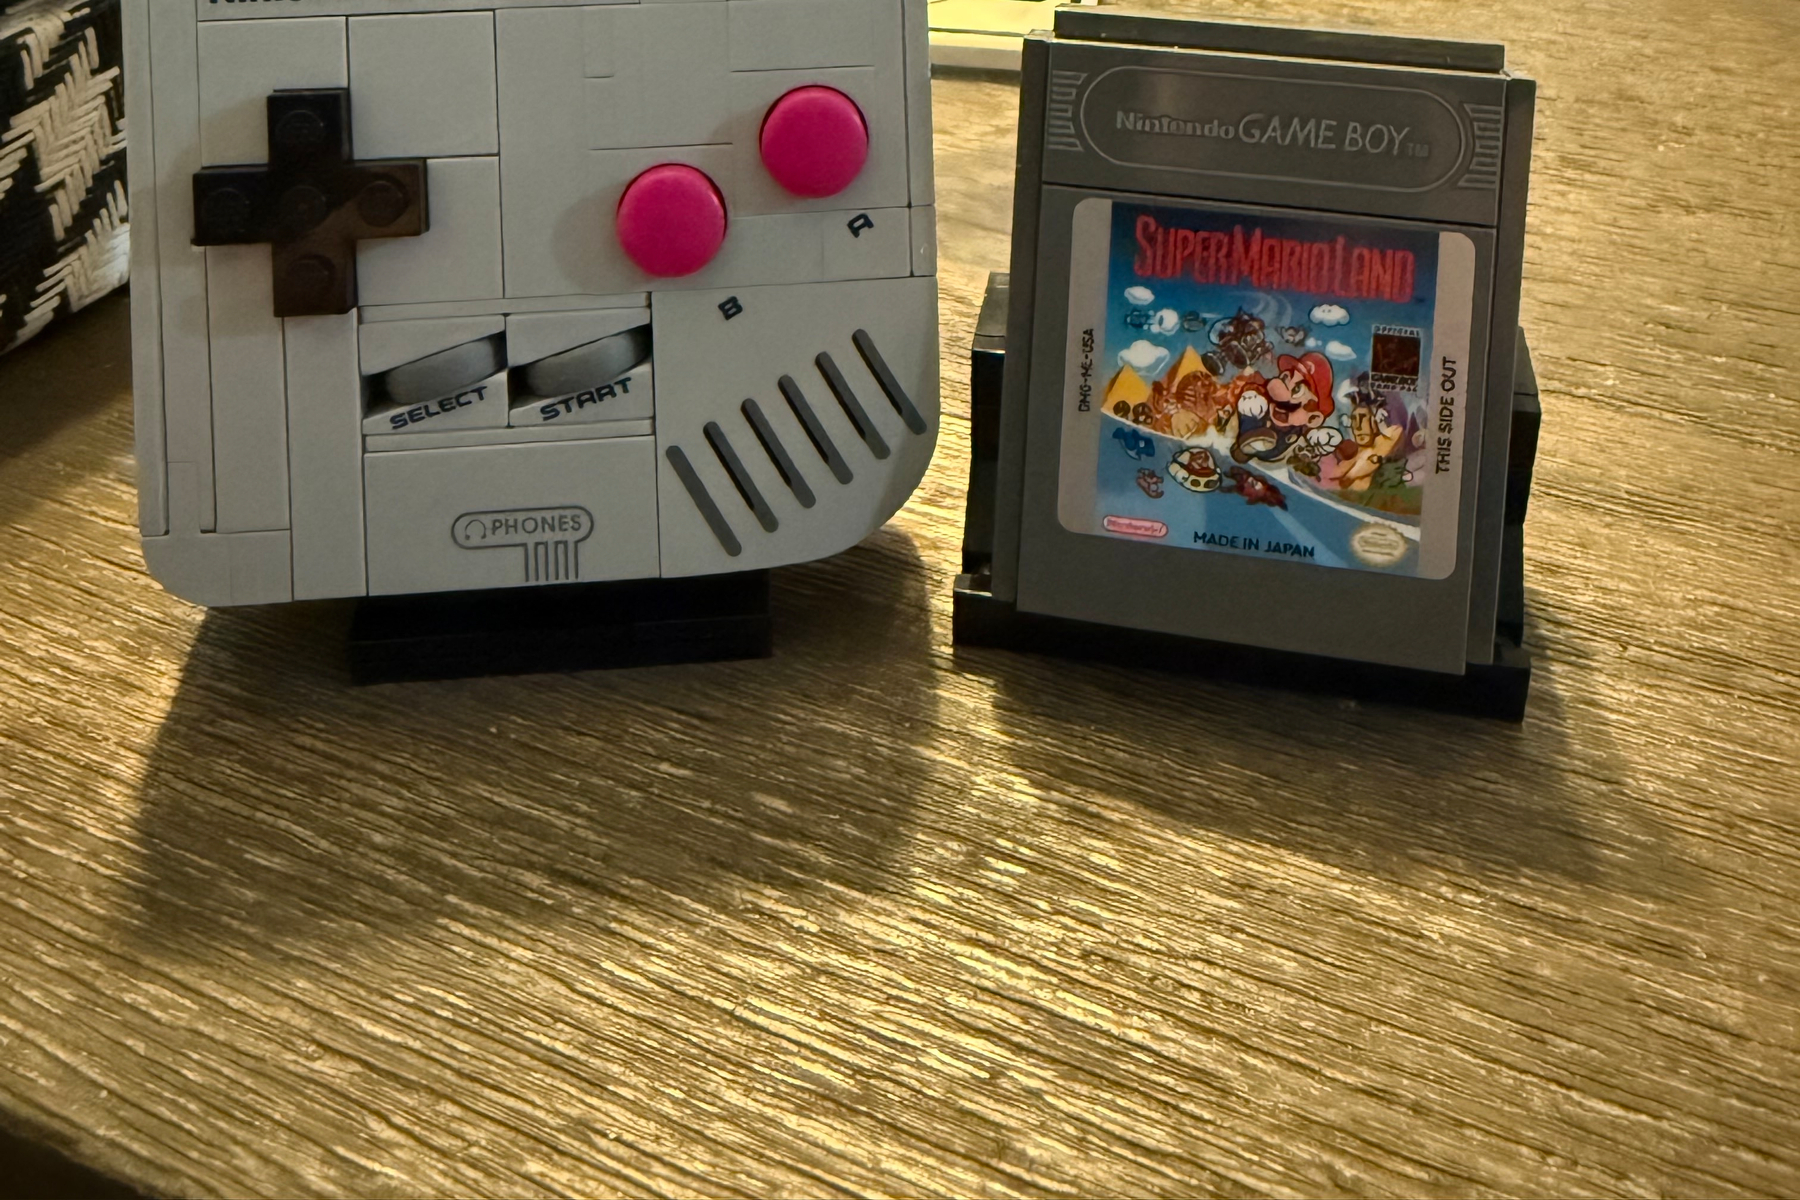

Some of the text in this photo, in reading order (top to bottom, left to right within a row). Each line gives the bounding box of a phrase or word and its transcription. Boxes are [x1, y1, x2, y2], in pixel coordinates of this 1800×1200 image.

[1115, 110, 1236, 140] Nintendo
[1237, 112, 1338, 150] GAME
[847, 212, 875, 239] A
[717, 295, 744, 321] B
[389, 385, 489, 431] SELECT
[539, 376, 633, 422] START
[1435, 355, 1457, 475] THIS SIDE OUT
[491, 513, 583, 536] PHONES
[1193, 531, 1316, 559] MADE IN JAPAN
